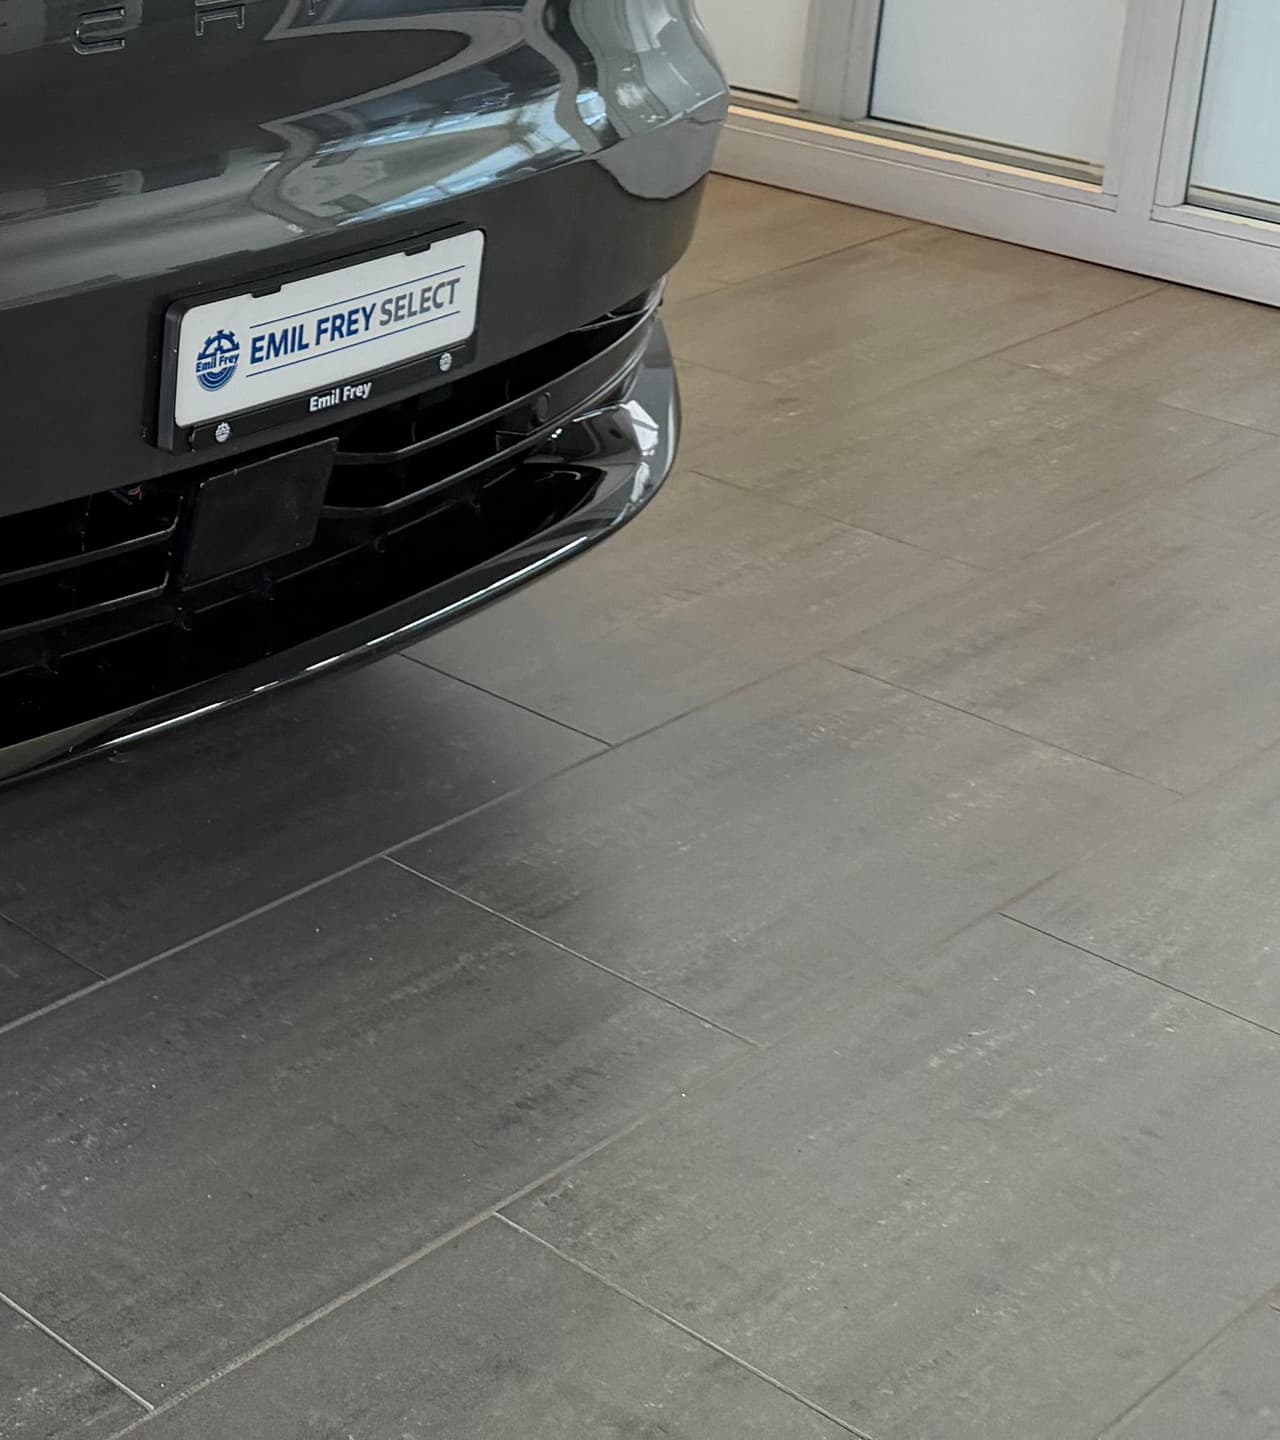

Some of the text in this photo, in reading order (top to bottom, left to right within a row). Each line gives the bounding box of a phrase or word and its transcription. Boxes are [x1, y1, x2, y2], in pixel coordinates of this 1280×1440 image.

[249, 277, 461, 365] EMIL FREY SELECT
[195, 353, 240, 373] Emil Frey
[309, 381, 372, 412] Emil Frey
